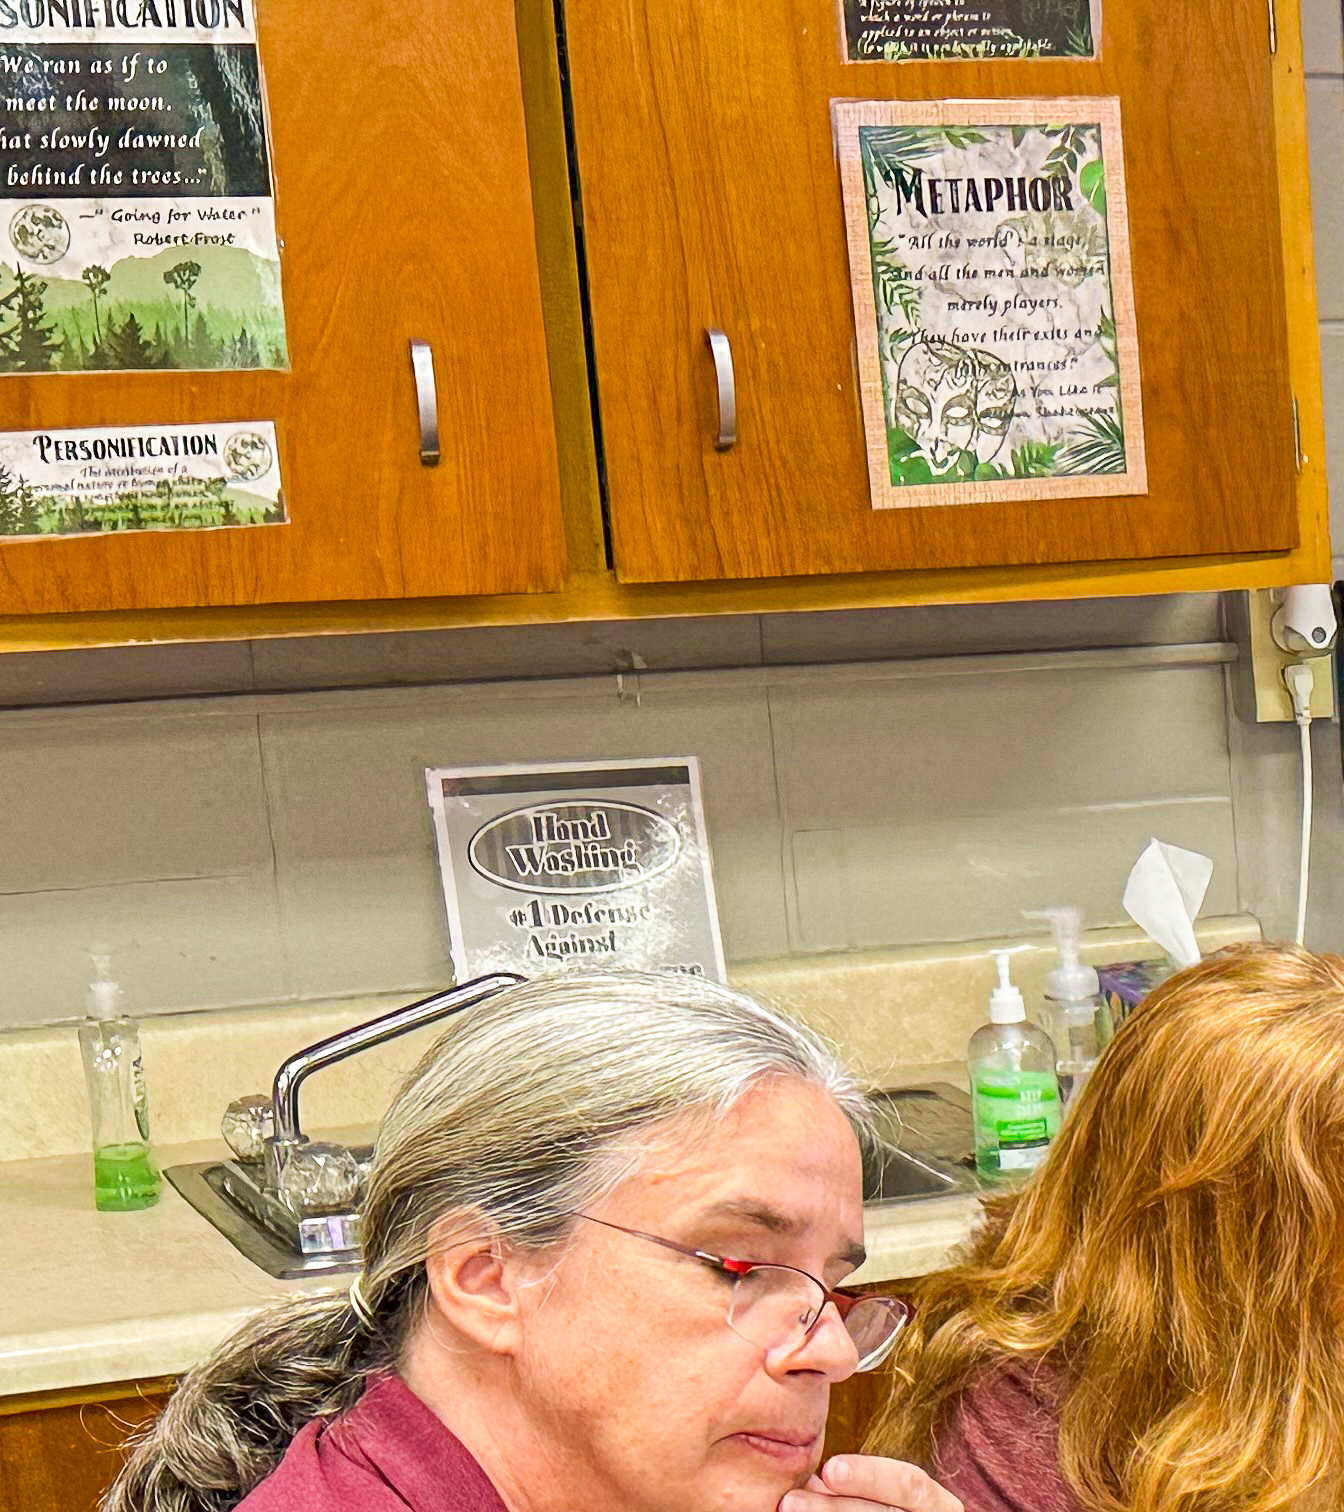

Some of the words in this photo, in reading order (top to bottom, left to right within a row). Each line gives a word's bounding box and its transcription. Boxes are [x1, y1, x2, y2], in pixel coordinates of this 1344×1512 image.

[43, 58, 81, 74] ran
[90, 57, 113, 74] as
[121, 52, 141, 82] if
[148, 57, 168, 74] to
[5, 94, 56, 111] meet
[66, 89, 99, 111] the
[40, 126, 110, 157] slowly
[118, 126, 206, 149] dawned
[7, 163, 85, 186] behind
[90, 163, 123, 185] the
[886, 168, 1074, 217] METAPHOR
[167, 208, 189, 224] for
[133, 233, 188, 245] Robert
[33, 433, 218, 464] PERSONIFICATION
[531, 811, 611, 842] Hand
[507, 841, 641, 878] Washing
[510, 899, 544, 928] #1
[551, 902, 651, 926] Defense
[530, 930, 616, 961] Against
